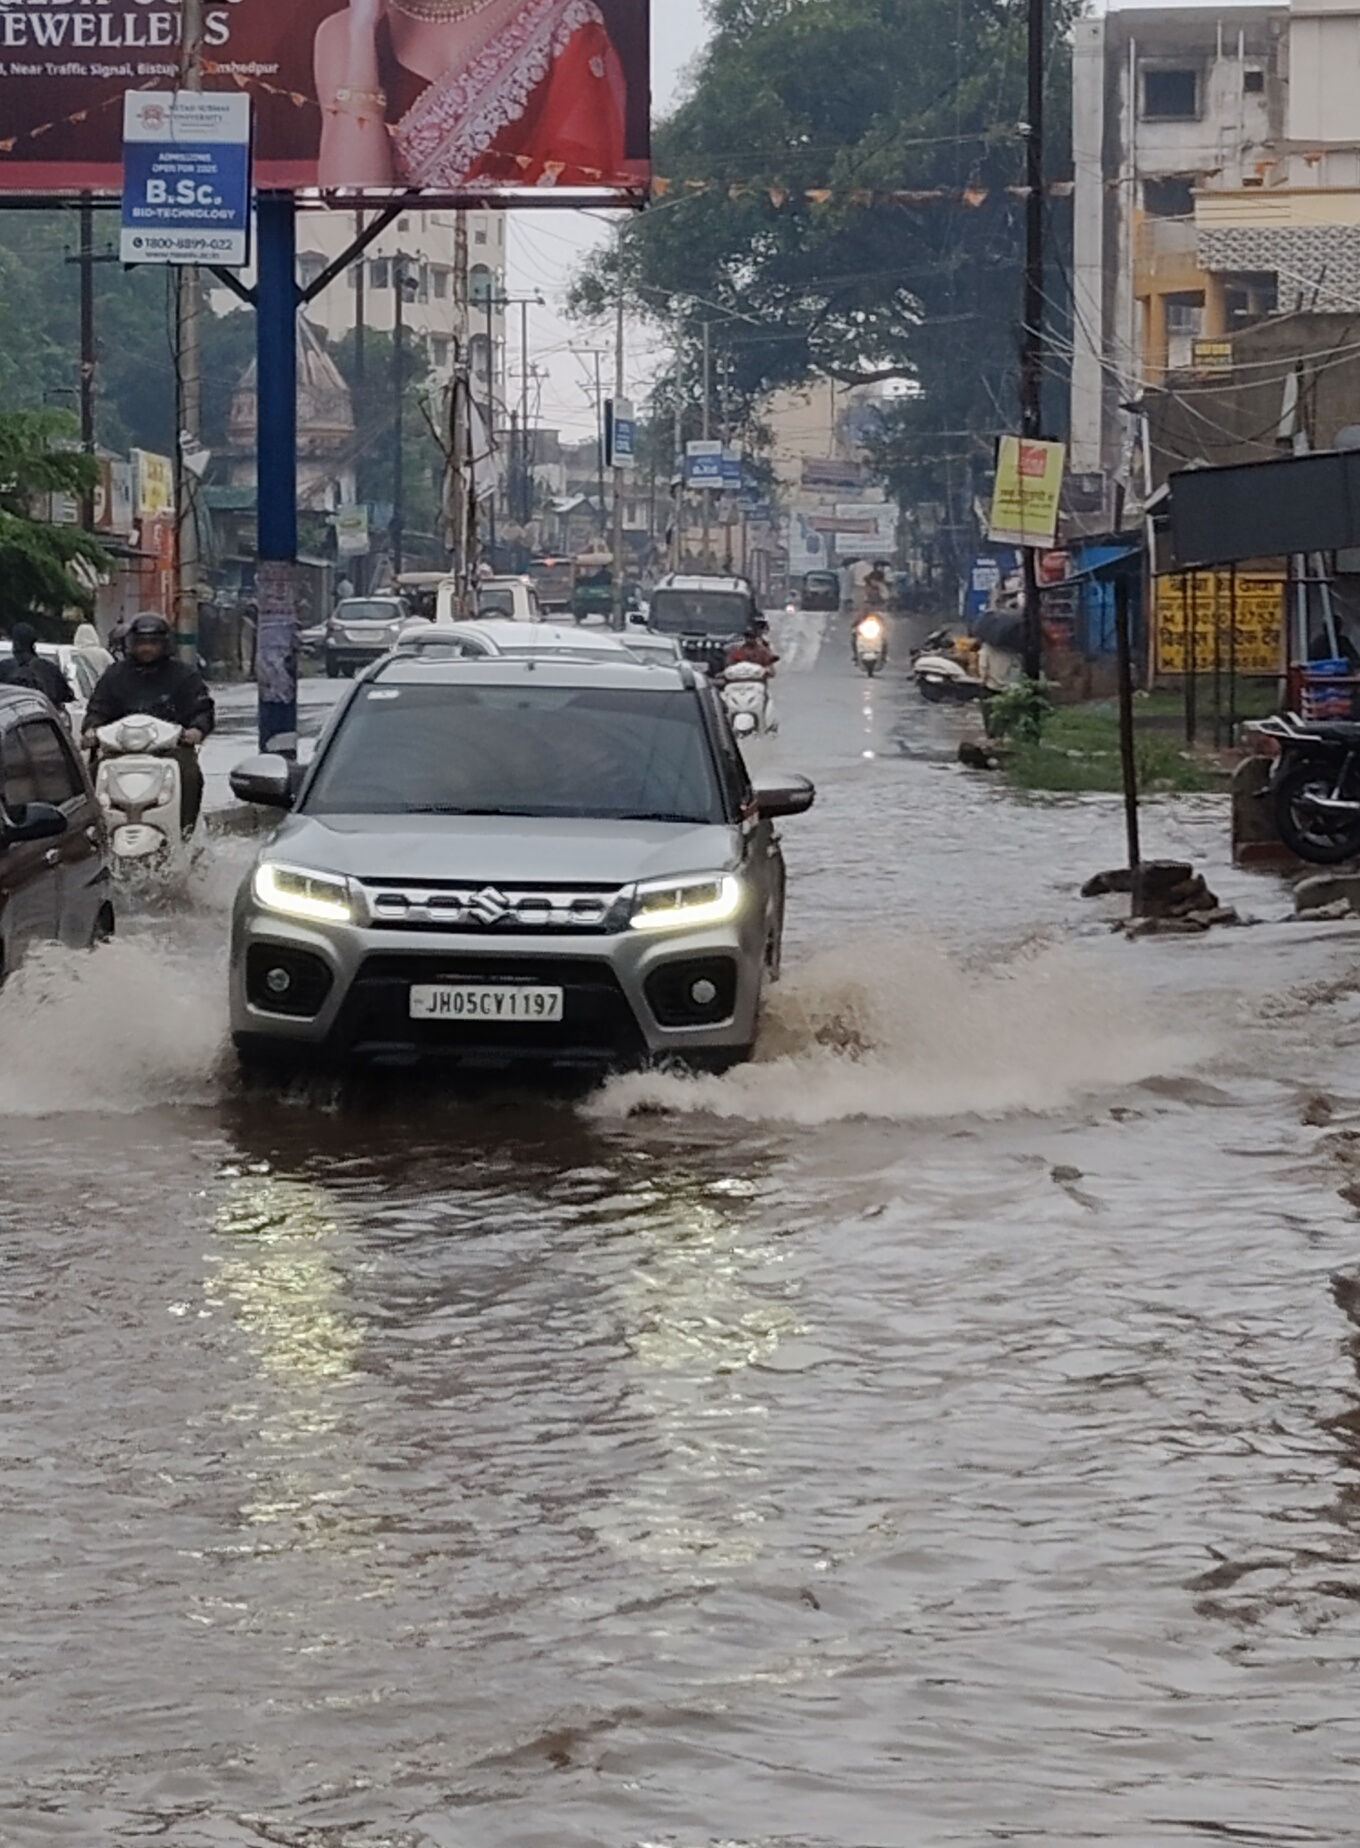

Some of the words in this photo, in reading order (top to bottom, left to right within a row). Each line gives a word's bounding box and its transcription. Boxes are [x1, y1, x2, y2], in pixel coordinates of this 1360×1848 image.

[10, 62, 42, 75] Near
[46, 62, 87, 75] Traffic
[90, 63, 133, 78] Signal,
[206, 62, 278, 77] mshedpur
[152, 164, 176, 173] OPEN
[178, 164, 194, 173] FOR
[146, 179, 222, 205] B.Sc.
[132, 208, 236, 219] BIO-TECHNOLOGY
